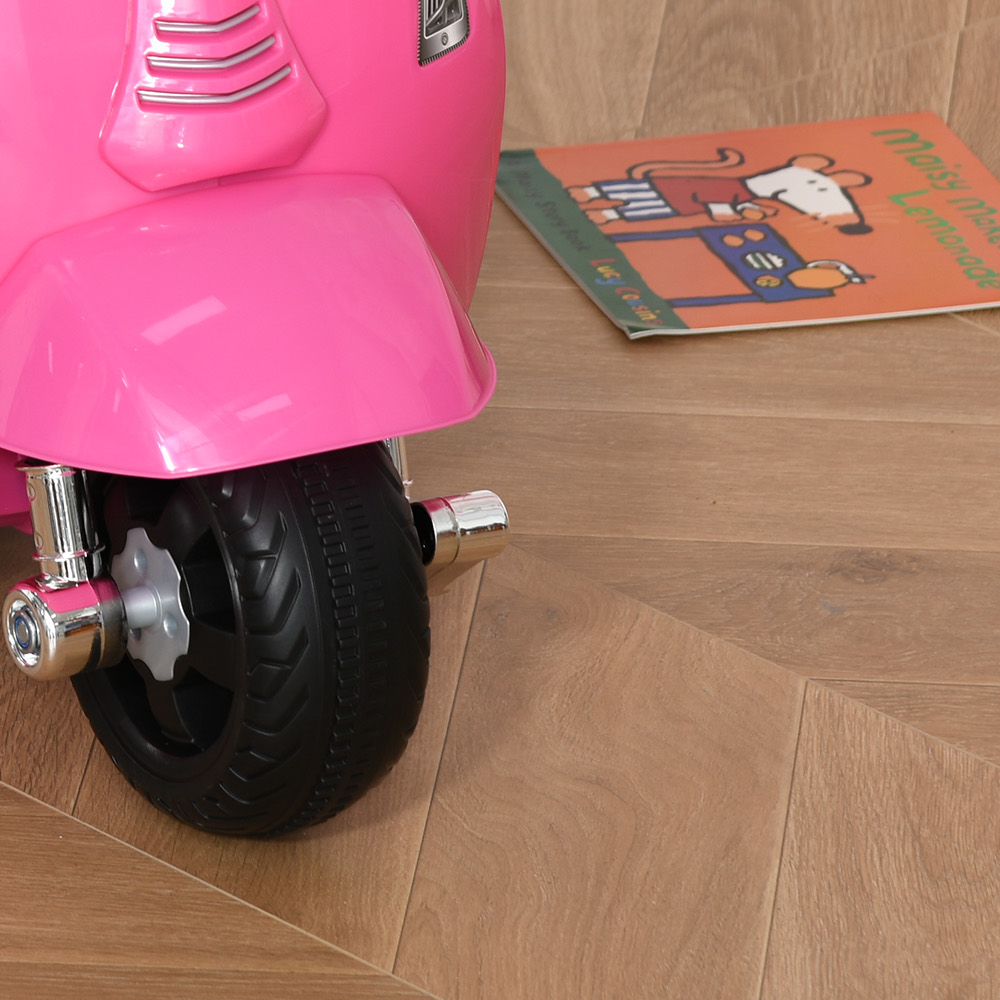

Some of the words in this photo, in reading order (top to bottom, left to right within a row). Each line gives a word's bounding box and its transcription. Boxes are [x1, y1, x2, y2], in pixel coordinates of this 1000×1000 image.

[871, 128, 973, 191] Maisy
[589, 257, 626, 286] Lucy
[615, 286, 664, 326] Cousins
